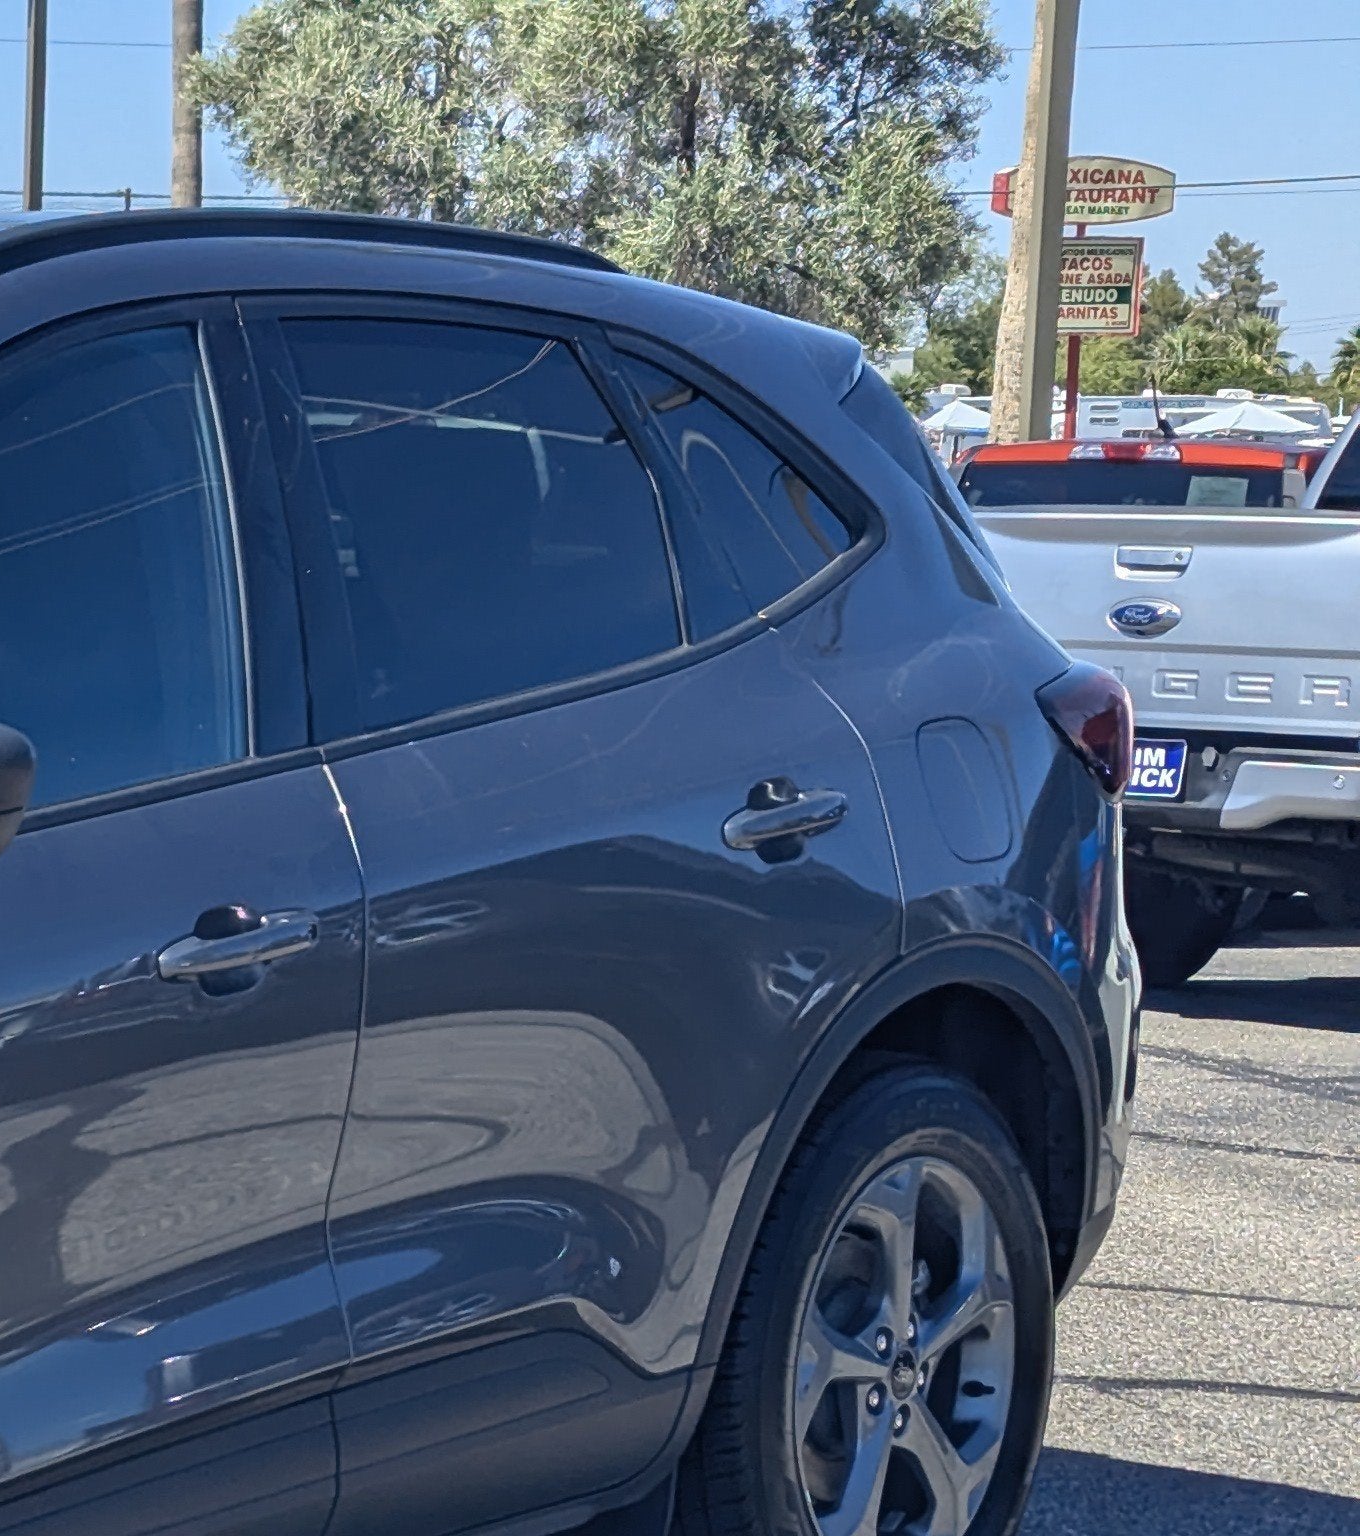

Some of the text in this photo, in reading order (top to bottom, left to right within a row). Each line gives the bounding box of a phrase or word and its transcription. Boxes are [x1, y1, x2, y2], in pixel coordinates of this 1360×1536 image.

[1069, 168, 1146, 185] XICANA
[1066, 187, 1159, 204] TAURANT
[1066, 205, 1130, 215] EAT MARKET
[1087, 273, 1131, 285] ASADA
[1061, 288, 1118, 303] ENUDO
[1058, 307, 1118, 319] ARNITAS
[1151, 668, 1352, 708] GER
[1134, 747, 1166, 767] IM
[1131, 767, 1177, 788] ICK
